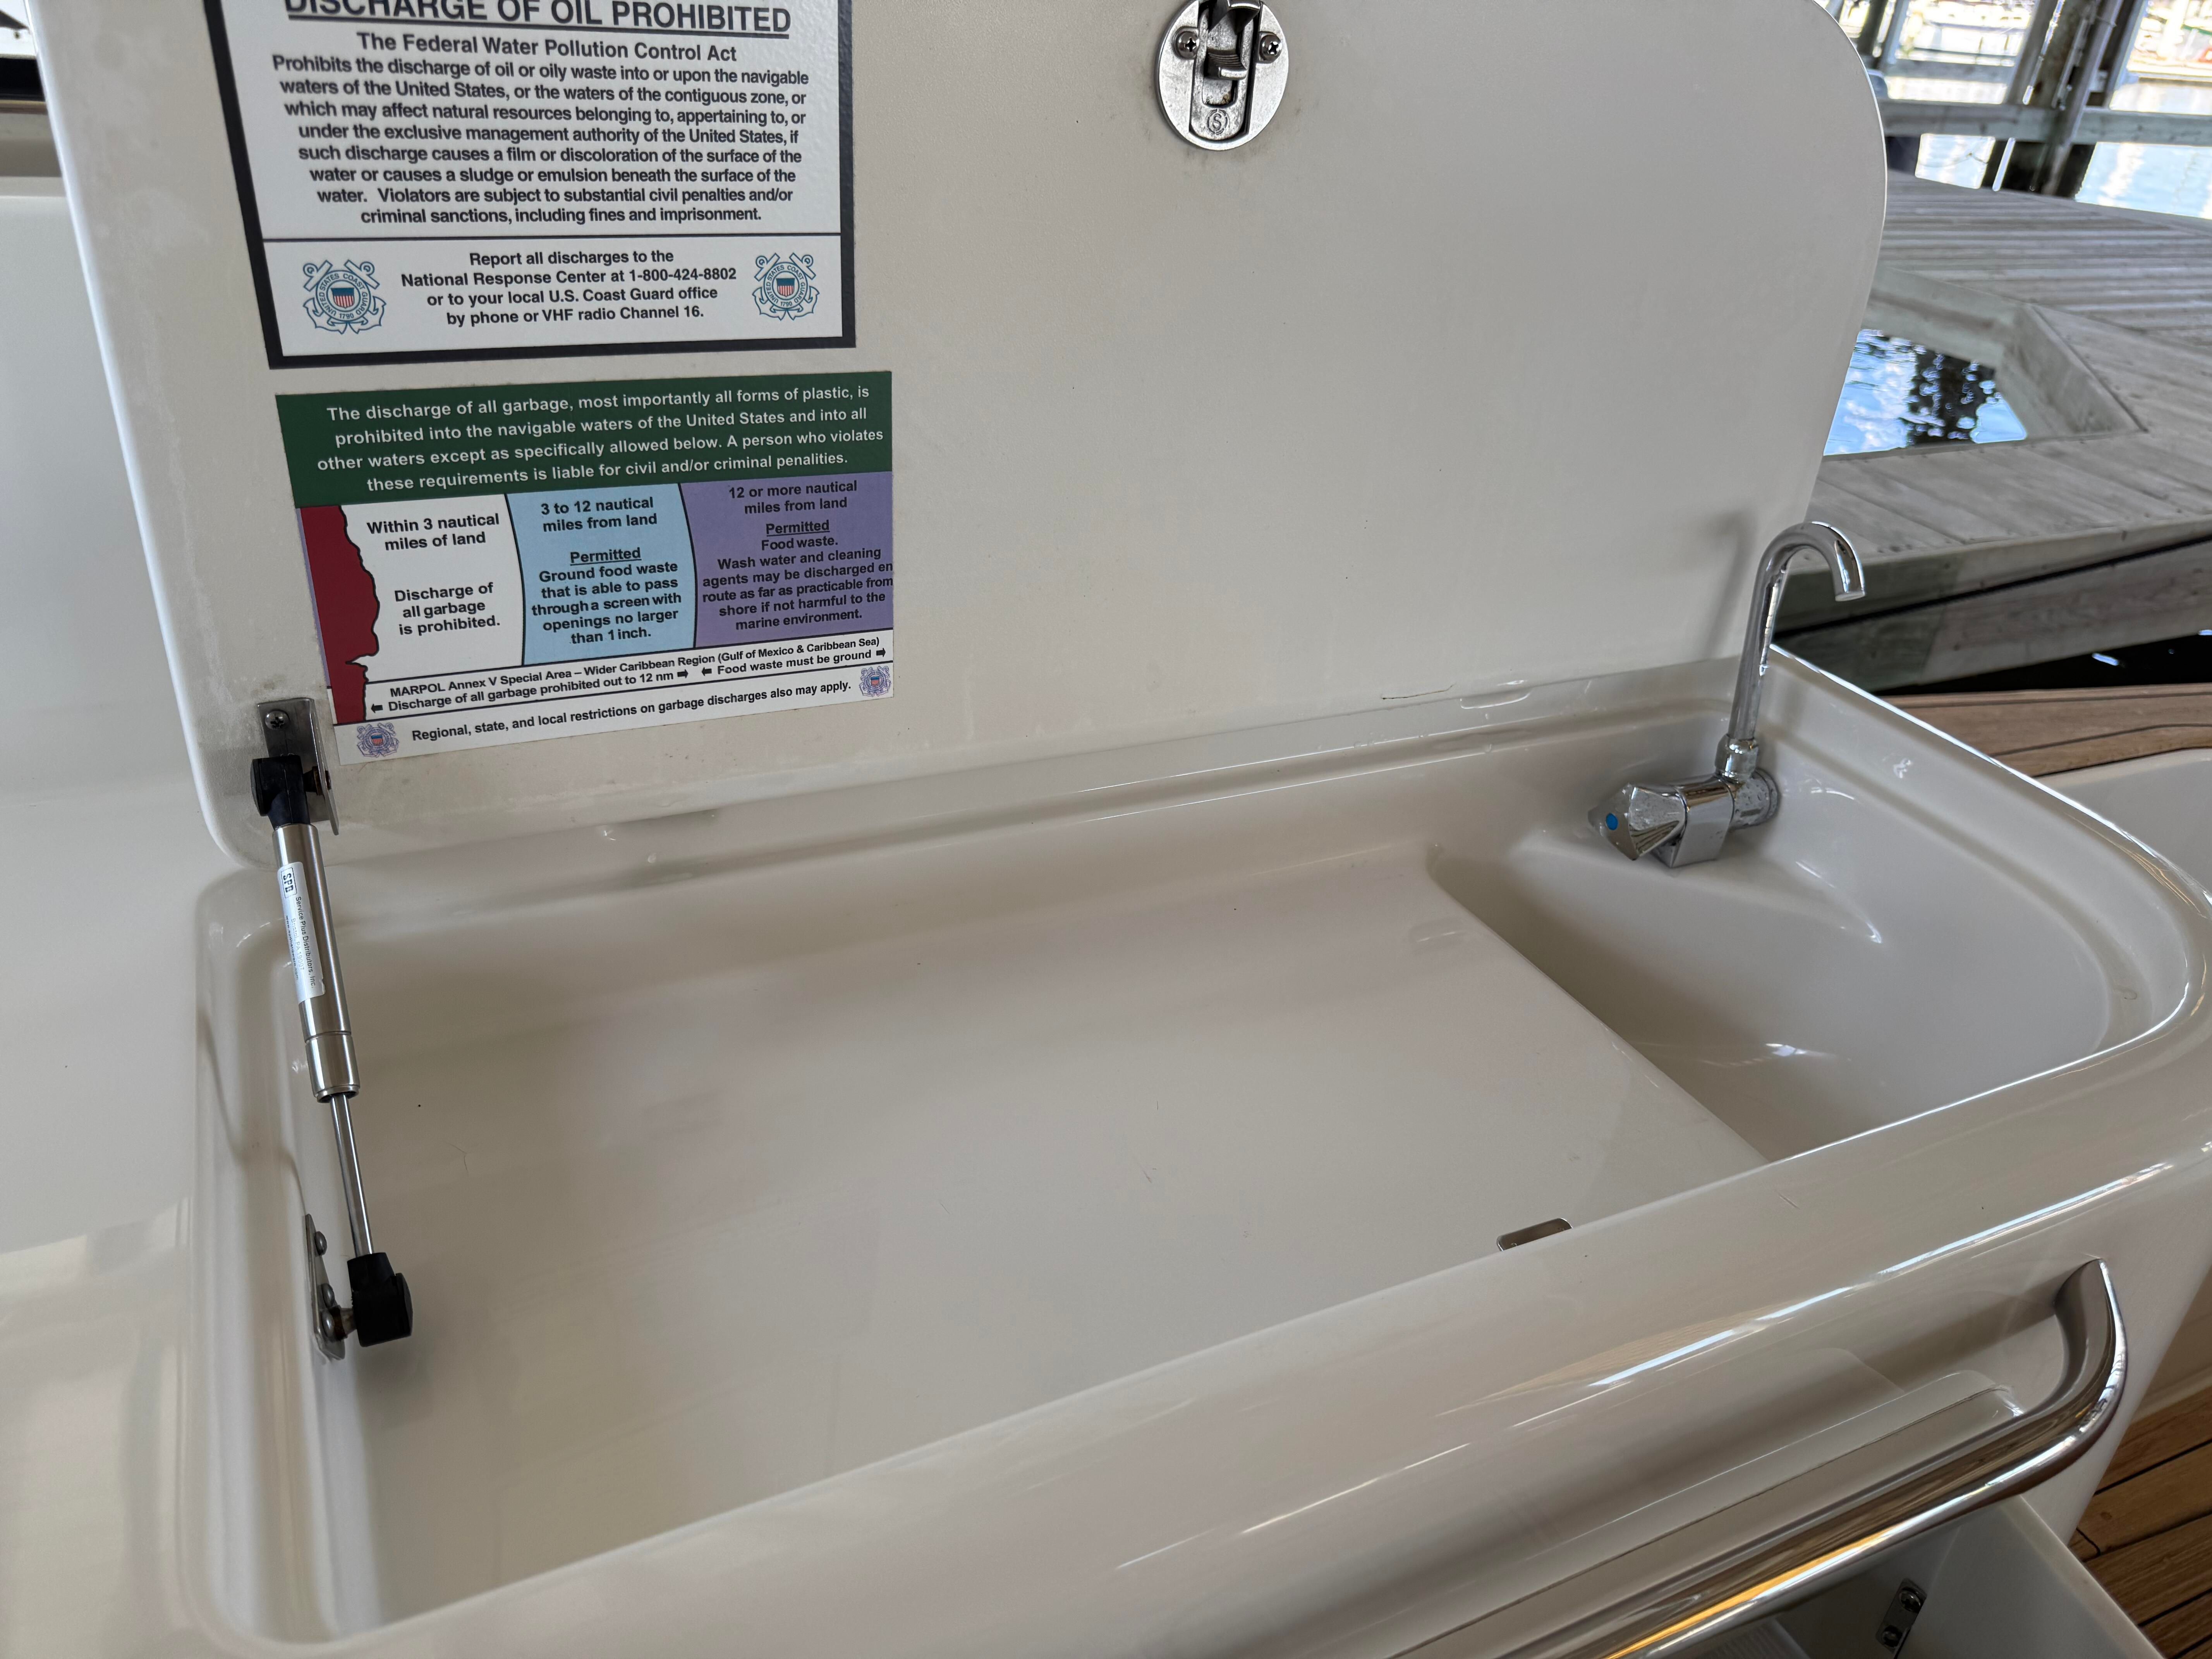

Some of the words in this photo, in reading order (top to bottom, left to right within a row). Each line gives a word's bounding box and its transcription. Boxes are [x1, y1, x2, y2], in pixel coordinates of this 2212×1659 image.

[498, 0, 540, 22] OF
[551, 0, 602, 25] OIL
[612, 1, 791, 32] PROHIBITED
[356, 32, 396, 50] The
[403, 34, 477, 53] Federal
[482, 37, 538, 55] Water
[545, 39, 628, 58] Pollution
[634, 42, 701, 60] Control
[708, 45, 737, 61] Act
[317, 189, 367, 202] water.
[377, 188, 451, 202] Violators
[455, 191, 480, 202] are
[484, 188, 541, 205] subject
[544, 189, 560, 202] to
[564, 188, 645, 202] substantial
[649, 188, 678, 201] civil
[682, 188, 745, 204] penalties
[749, 188, 793, 201] and/or
[361, 209, 426, 223] criminal
[431, 208, 512, 225] sanctions,
[515, 208, 585, 225] including
[589, 208, 625, 221] fines
[629, 208, 656, 221] and
[660, 207, 761, 224] imprisonment.
[470, 253, 522, 268] Report
[526, 252, 543, 264] all
[548, 251, 629, 266] discharges
[633, 251, 647, 263] to
[651, 250, 673, 262] the
[319, 273, 340, 291] STATES
[343, 273, 365, 290] COAST
[401, 273, 468, 287] National
[474, 273, 551, 287] Response
[556, 271, 606, 283] Center
[611, 270, 625, 282] at
[629, 268, 736, 281] 1-800-424-8802
[768, 265, 785, 280] STATES
[787, 265, 804, 280] COAST
[427, 296, 443, 306] or
[448, 294, 464, 305] to
[468, 294, 503, 308] your
[508, 290, 544, 303] local
[549, 290, 579, 302] U.S.
[583, 289, 626, 301] Coast
[630, 287, 674, 300] Guard
[678, 287, 718, 299] office
[766, 282, 778, 304] UNITED
[794, 282, 805, 303] GUARD
[319, 292, 337, 316] UNITED
[356, 292, 368, 315] GUARD
[447, 313, 465, 327] by
[471, 311, 519, 327] phone
[524, 313, 539, 322] or
[542, 309, 573, 321] VHF
[579, 308, 615, 320] radio
[620, 306, 679, 319] Channel
[684, 306, 703, 317] 16.
[326, 407, 360, 421] The
[366, 404, 451, 419] discharge
[457, 401, 473, 414] of
[479, 400, 496, 413] all
[503, 398, 573, 415] garbage,
[579, 395, 618, 408] most
[623, 392, 710, 409] importantly
[716, 390, 732, 403] all
[737, 390, 779, 402] forms
[785, 388, 799, 400] of
[803, 386, 853, 402] plastic,
[858, 386, 869, 397] is
[367, 478, 414, 491] these
[419, 470, 528, 489] requirements
[534, 468, 547, 480] is
[553, 465, 594, 479] liable
[599, 464, 621, 476] for
[626, 462, 656, 474] civil
[662, 459, 709, 472] and/or
[714, 455, 771, 470] criminal
[777, 452, 847, 469] penalities.
[729, 487, 744, 498] 12
[749, 488, 763, 497] or
[768, 486, 801, 496] more
[806, 480, 857, 494] nautical
[541, 503, 550, 515] 3
[554, 503, 569, 514] to
[574, 500, 591, 512] 12
[596, 496, 653, 511] nautical
[745, 502, 780, 514] miles
[784, 500, 815, 511] from
[820, 497, 847, 509] land
[366, 520, 419, 534] Within
[424, 518, 433, 530] 3
[438, 513, 499, 529] nautical
[543, 519, 583, 532] miles
[587, 517, 622, 529] from
[626, 513, 657, 526] land
[766, 519, 829, 534] Permitted
[385, 538, 428, 550] miles
[432, 534, 447, 547] of
[452, 531, 486, 545] land
[762, 538, 794, 551] Food
[796, 536, 838, 548] waste.
[570, 547, 641, 563] Permitted
[395, 587, 473, 602] Discharge
[478, 582, 493, 594] of
[403, 605, 421, 618] all
[424, 602, 485, 618] garbage
[736, 617, 780, 630] marine
[783, 609, 862, 625] environment.
[399, 624, 412, 635] is
[417, 615, 500, 636] prohibited.
[571, 633, 603, 644] than
[608, 630, 614, 640] 1
[618, 627, 651, 639] inch.
[718, 663, 746, 675] Food
[750, 660, 783, 671] waste
[787, 656, 814, 667] must
[817, 655, 830, 664] be
[833, 649, 871, 664] ground
[388, 697, 452, 711] Discharge
[455, 693, 467, 703] of
[471, 691, 484, 701] all
[488, 688, 537, 702] garbage
[540, 678, 600, 696] prohibited
[603, 677, 623, 687] out
[625, 676, 637, 685] to
[640, 673, 653, 683] 12
[656, 673, 673, 681] nm
[412, 725, 471, 741] Regional,
[475, 721, 508, 733] state,
[512, 716, 534, 728] and
[538, 713, 567, 725] local
[570, 707, 637, 721] restrictions
[641, 705, 655, 713] on
[658, 699, 704, 713] garbage
[708, 692, 767, 705] discharges
[771, 688, 792, 698] also
[796, 686, 817, 696] may
[821, 681, 851, 694] apply.
[283, 873, 294, 893] SPD
[295, 942, 301, 950] PA
[303, 936, 313, 975] Distributors,
